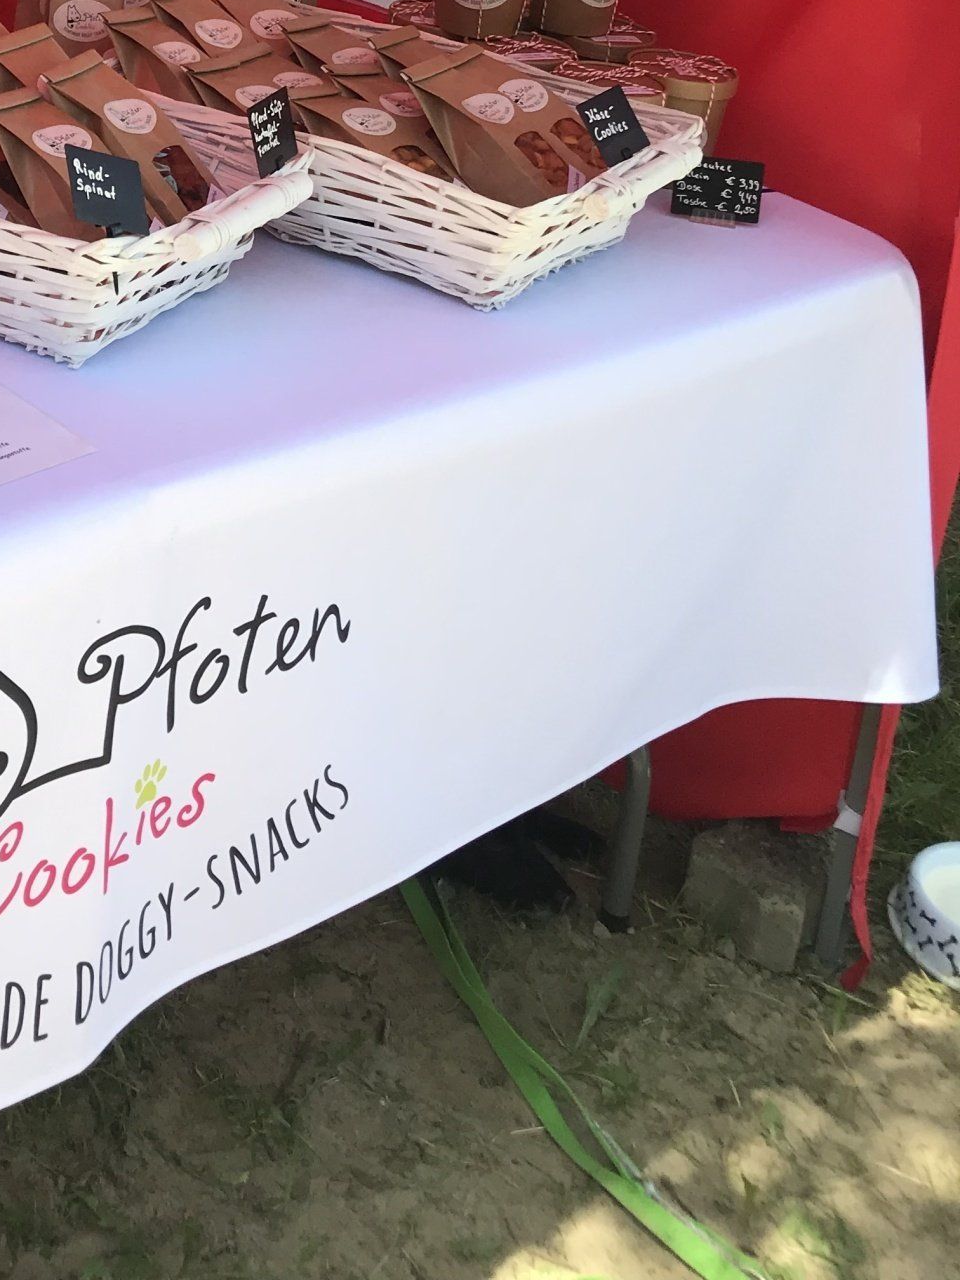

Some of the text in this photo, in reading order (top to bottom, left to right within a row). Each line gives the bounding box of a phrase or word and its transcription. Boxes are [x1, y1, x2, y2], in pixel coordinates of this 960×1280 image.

[584, 105, 614, 123] Käse-
[594, 120, 629, 141] Cookies
[73, 157, 110, 182] Rind-
[76, 177, 116, 200] Spinat
[676, 180, 703, 193] Dose
[721, 188, 733, 199] €
[687, 171, 760, 191] lein € 3,99
[675, 194, 757, 215] Tasche € 2,50
[78, 596, 351, 764] Pfoten
[75, 764, 350, 1025] DOGGY-SNACKS
